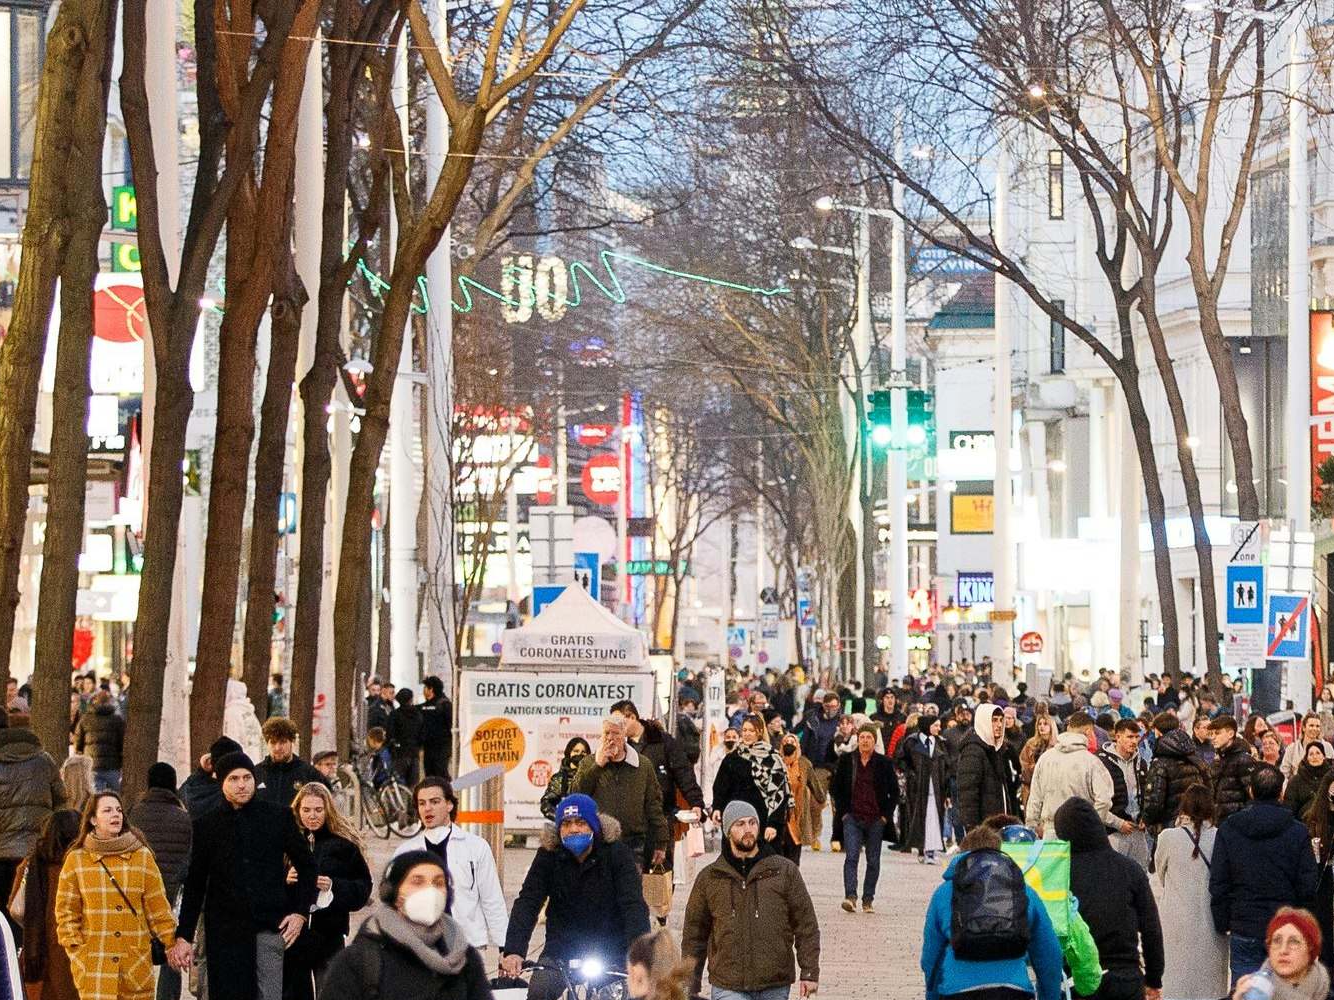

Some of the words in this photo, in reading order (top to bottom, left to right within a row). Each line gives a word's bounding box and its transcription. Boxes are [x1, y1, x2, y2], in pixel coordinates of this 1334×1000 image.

[550, 635, 595, 646] GRATIS
[519, 647, 627, 660] CORONATESTUNG
[475, 681, 531, 699] GRATIS
[535, 682, 636, 701] CORONATEST
[503, 705, 543, 716] ANTIGEN
[544, 705, 604, 717] SCHNELLTEST
[475, 727, 518, 741] SOFORT
[481, 740, 513, 751] OHNE
[475, 751, 520, 764] TERMIN
